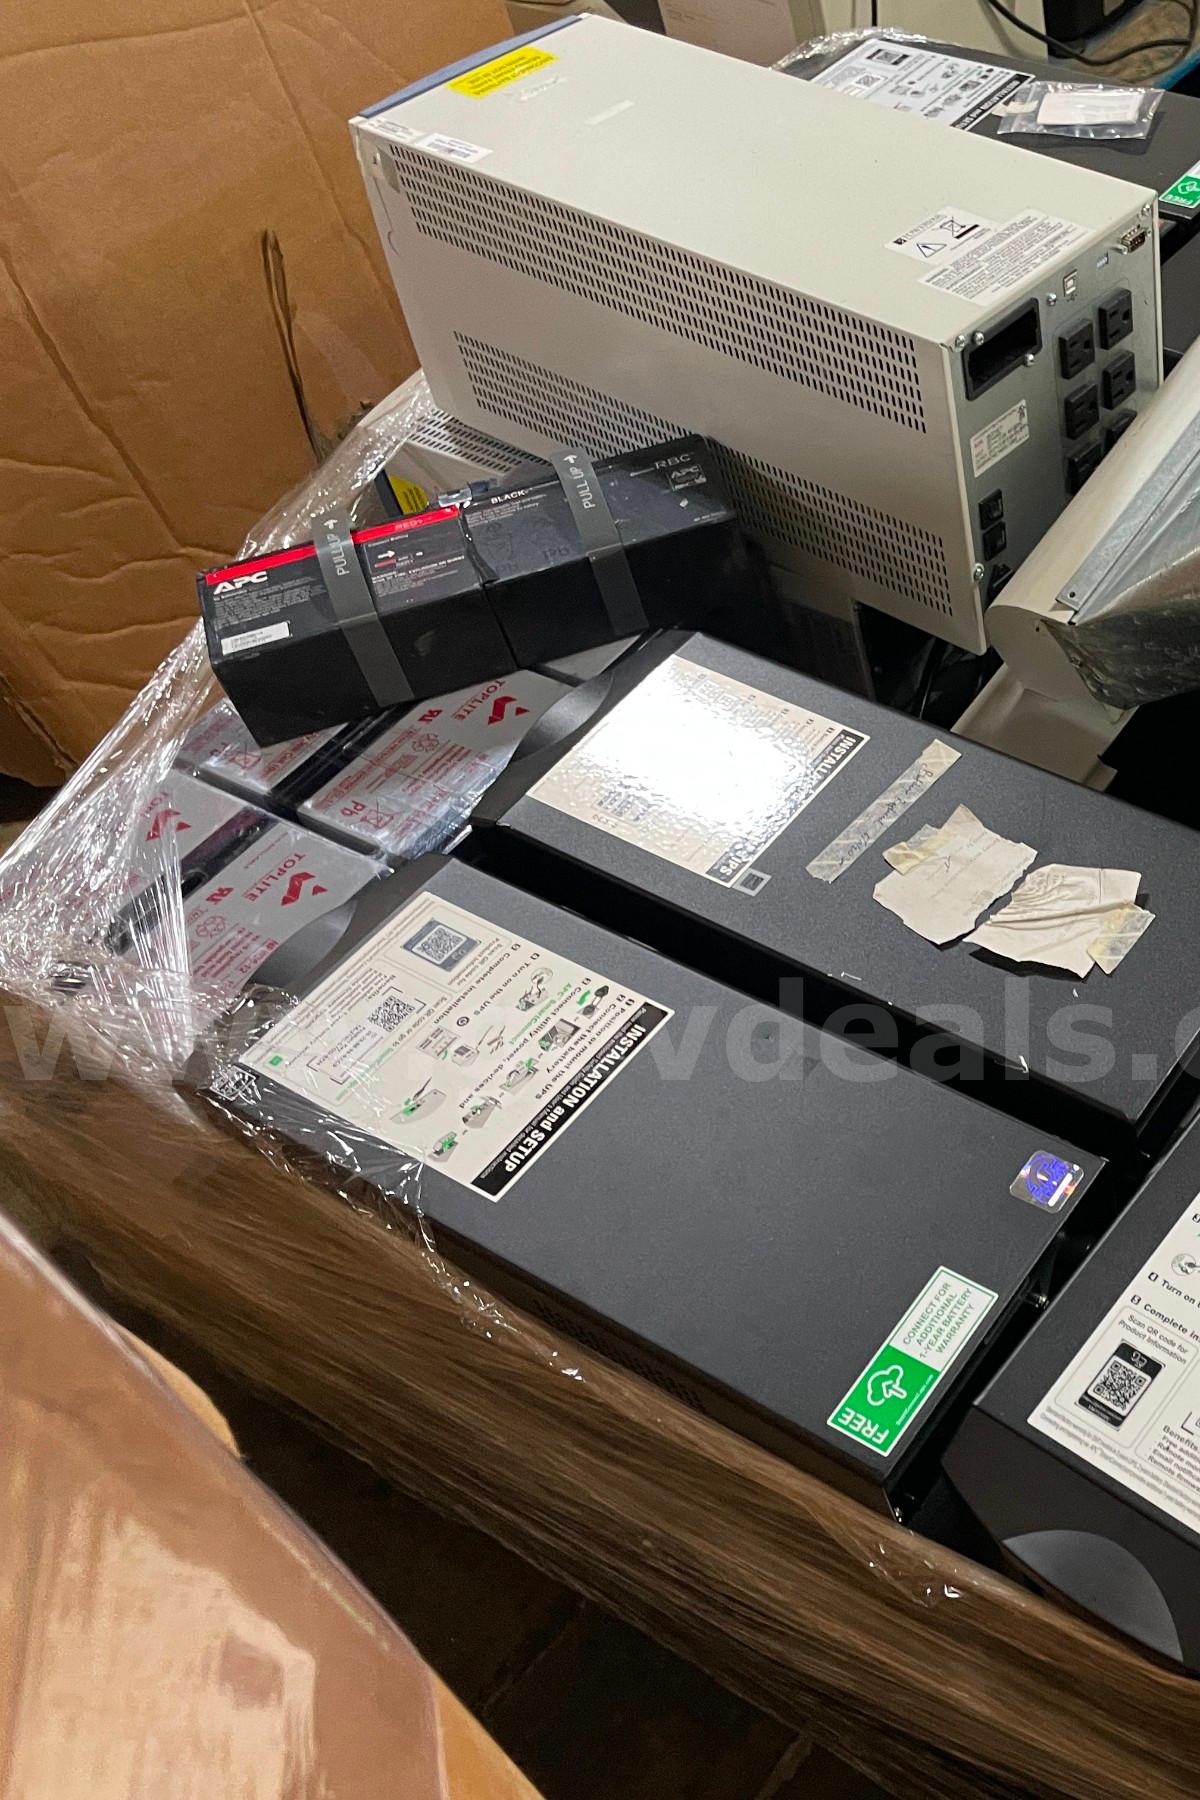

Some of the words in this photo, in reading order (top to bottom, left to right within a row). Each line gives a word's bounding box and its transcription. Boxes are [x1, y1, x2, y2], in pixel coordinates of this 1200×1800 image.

[569, 466, 584, 480] UP
[577, 480, 596, 509] PULL
[331, 545, 350, 576] PULL
[213, 571, 268, 595] APC
[452, 677, 506, 722] TOPLITE
[338, 799, 367, 819] Pb
[244, 849, 306, 903] TOPLITE
[473, 951, 511, 985] Complete
[500, 977, 513, 988] on
[510, 961, 530, 978] Turn
[432, 984, 477, 1025] installation
[472, 999, 491, 1016] UPS
[488, 987, 503, 1000] the
[583, 1002, 616, 1033] Connect
[594, 1006, 626, 1036] Position
[571, 1032, 587, 1046] the
[585, 1036, 597, 1045] or
[543, 1045, 575, 1074] battery
[560, 1023, 646, 1108] INSTALLATION
[562, 1044, 589, 1069] mount
[550, 1068, 566, 1083] the
[533, 1082, 553, 1100] UPS
[537, 1104, 570, 1131] and
[498, 1128, 547, 1173] SETUP
[1159, 1279, 1183, 1297] Turn
[1182, 1292, 1199, 1306] on
[901, 1300, 937, 1345] CONNECT
[932, 1281, 951, 1302] FOR
[914, 1291, 957, 1346] ADDITIONAL
[918, 1326, 946, 1359] 1-YEAR
[940, 1287, 973, 1327] BATTERY
[1141, 1302, 1189, 1335] Complete
[935, 1303, 975, 1354] WARRANTY
[1117, 1319, 1147, 1340] Product
[1145, 1335, 1188, 1365] Information
[1126, 1314, 1147, 1330] Scan
[1145, 1325, 1160, 1337] QR
[1157, 1332, 1174, 1346] code
[1172, 1341, 1189, 1355] for
[836, 1406, 890, 1445] FREE
[1159, 1434, 1179, 1450] Free
